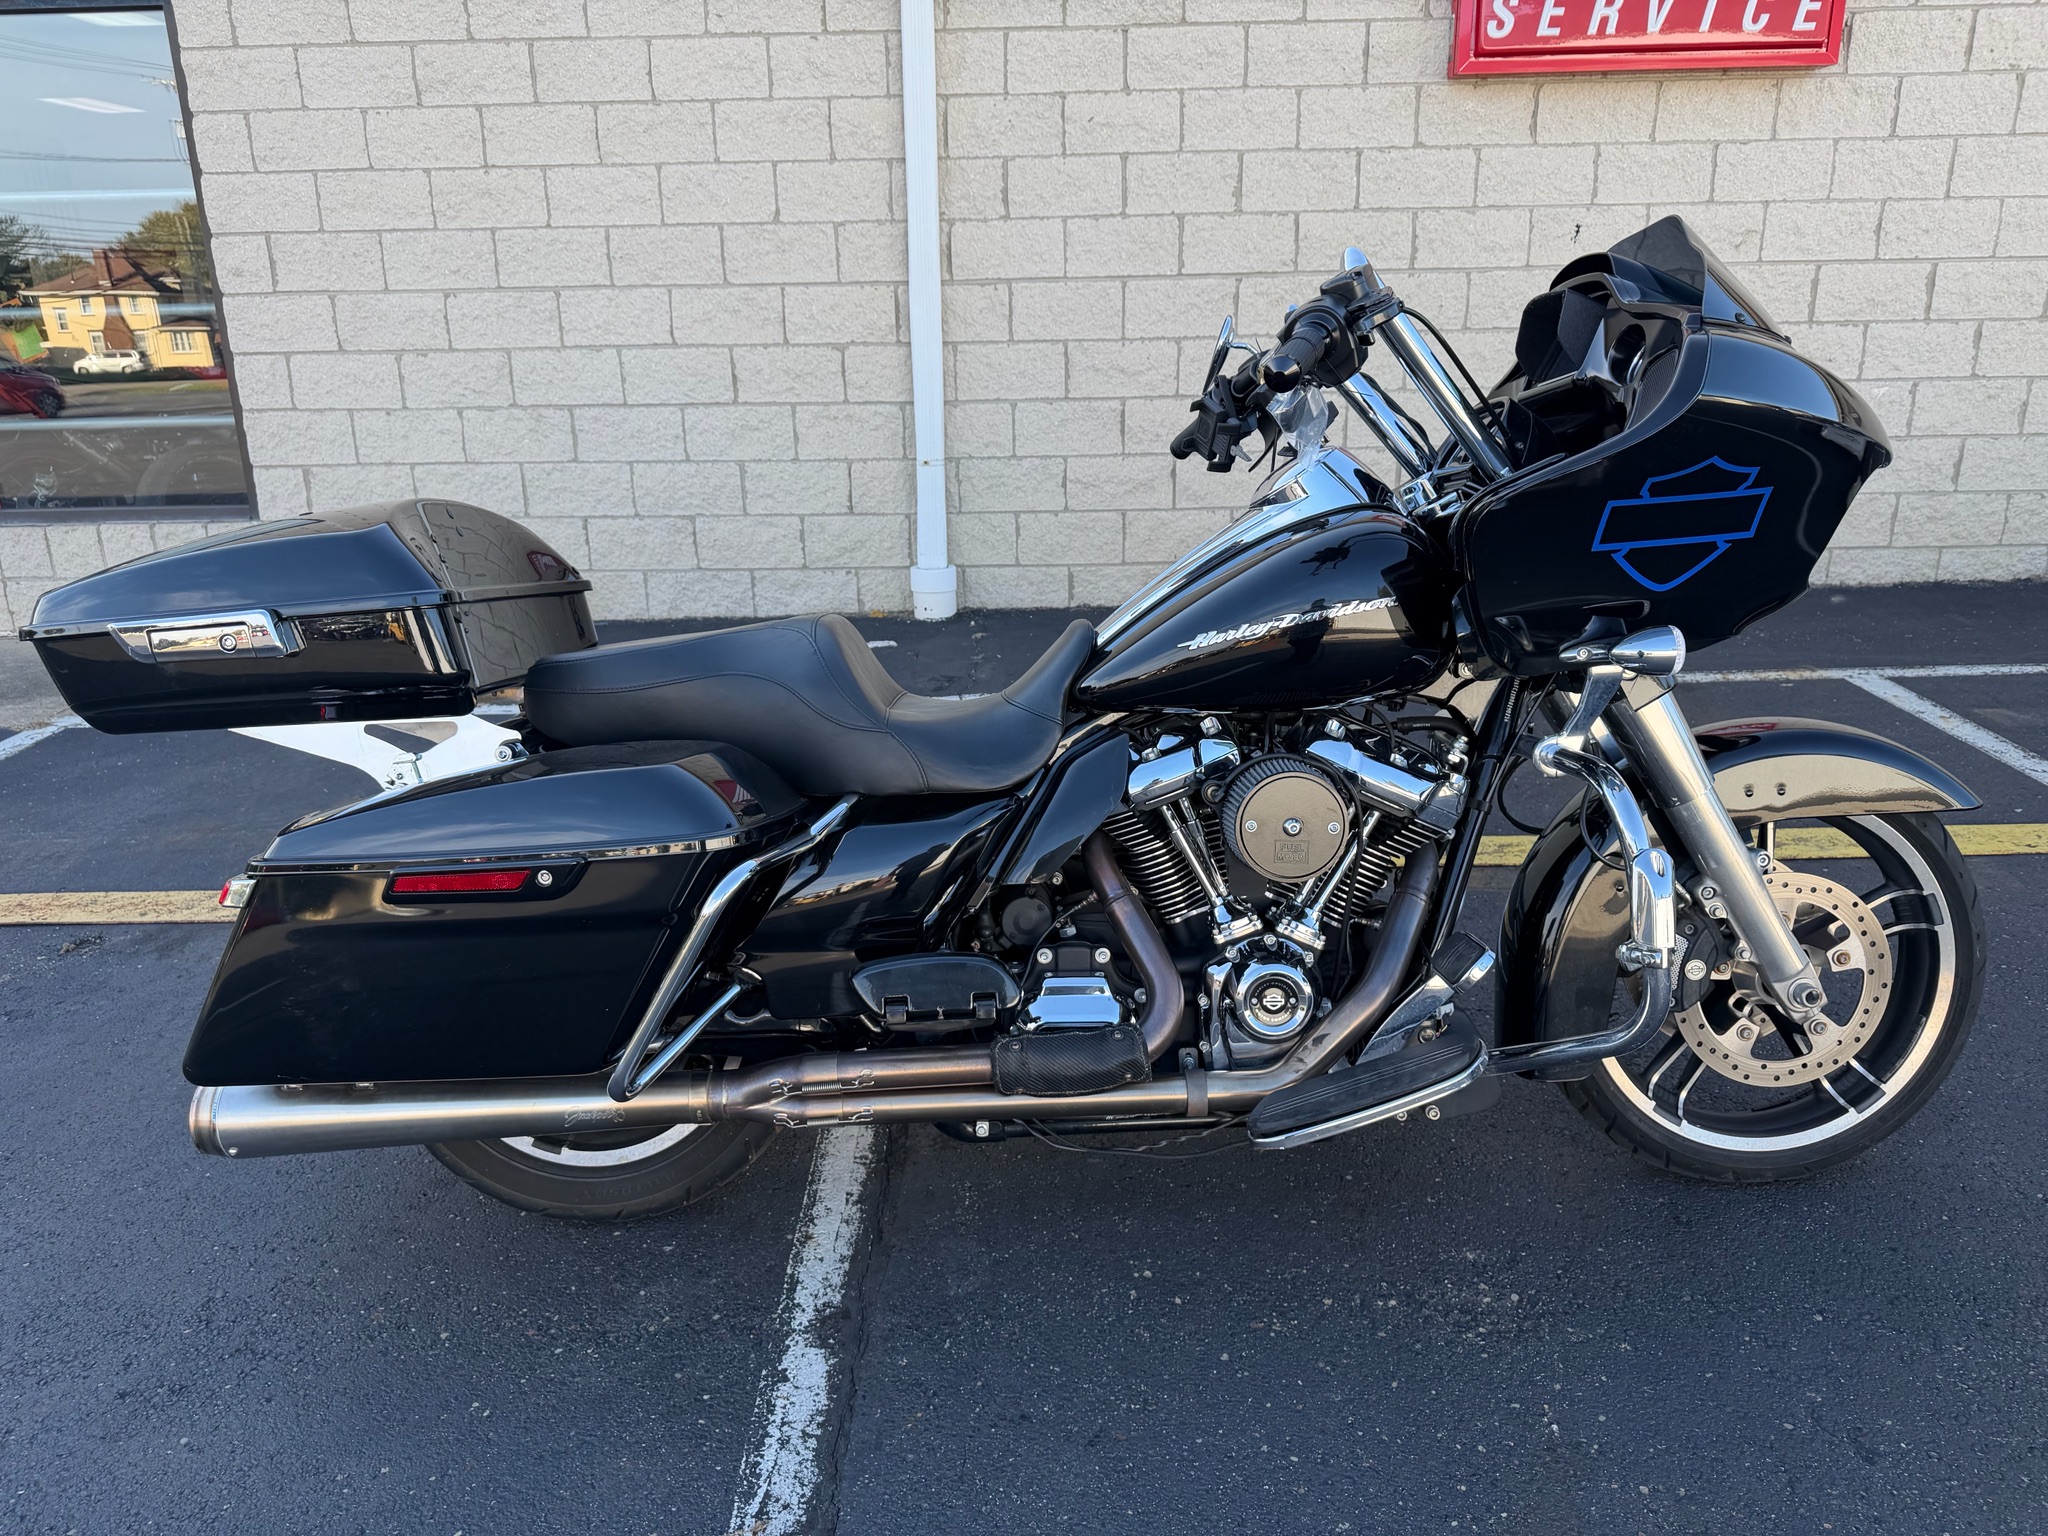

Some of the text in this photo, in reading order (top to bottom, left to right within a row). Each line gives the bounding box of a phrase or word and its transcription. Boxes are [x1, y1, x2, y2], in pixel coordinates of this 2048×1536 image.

[1485, 0, 1823, 38] SERVICE
[1177, 596, 1399, 650] Harley-Davidson
[1276, 852, 1307, 862] MOTO
[1279, 843, 1304, 852] FUEL
